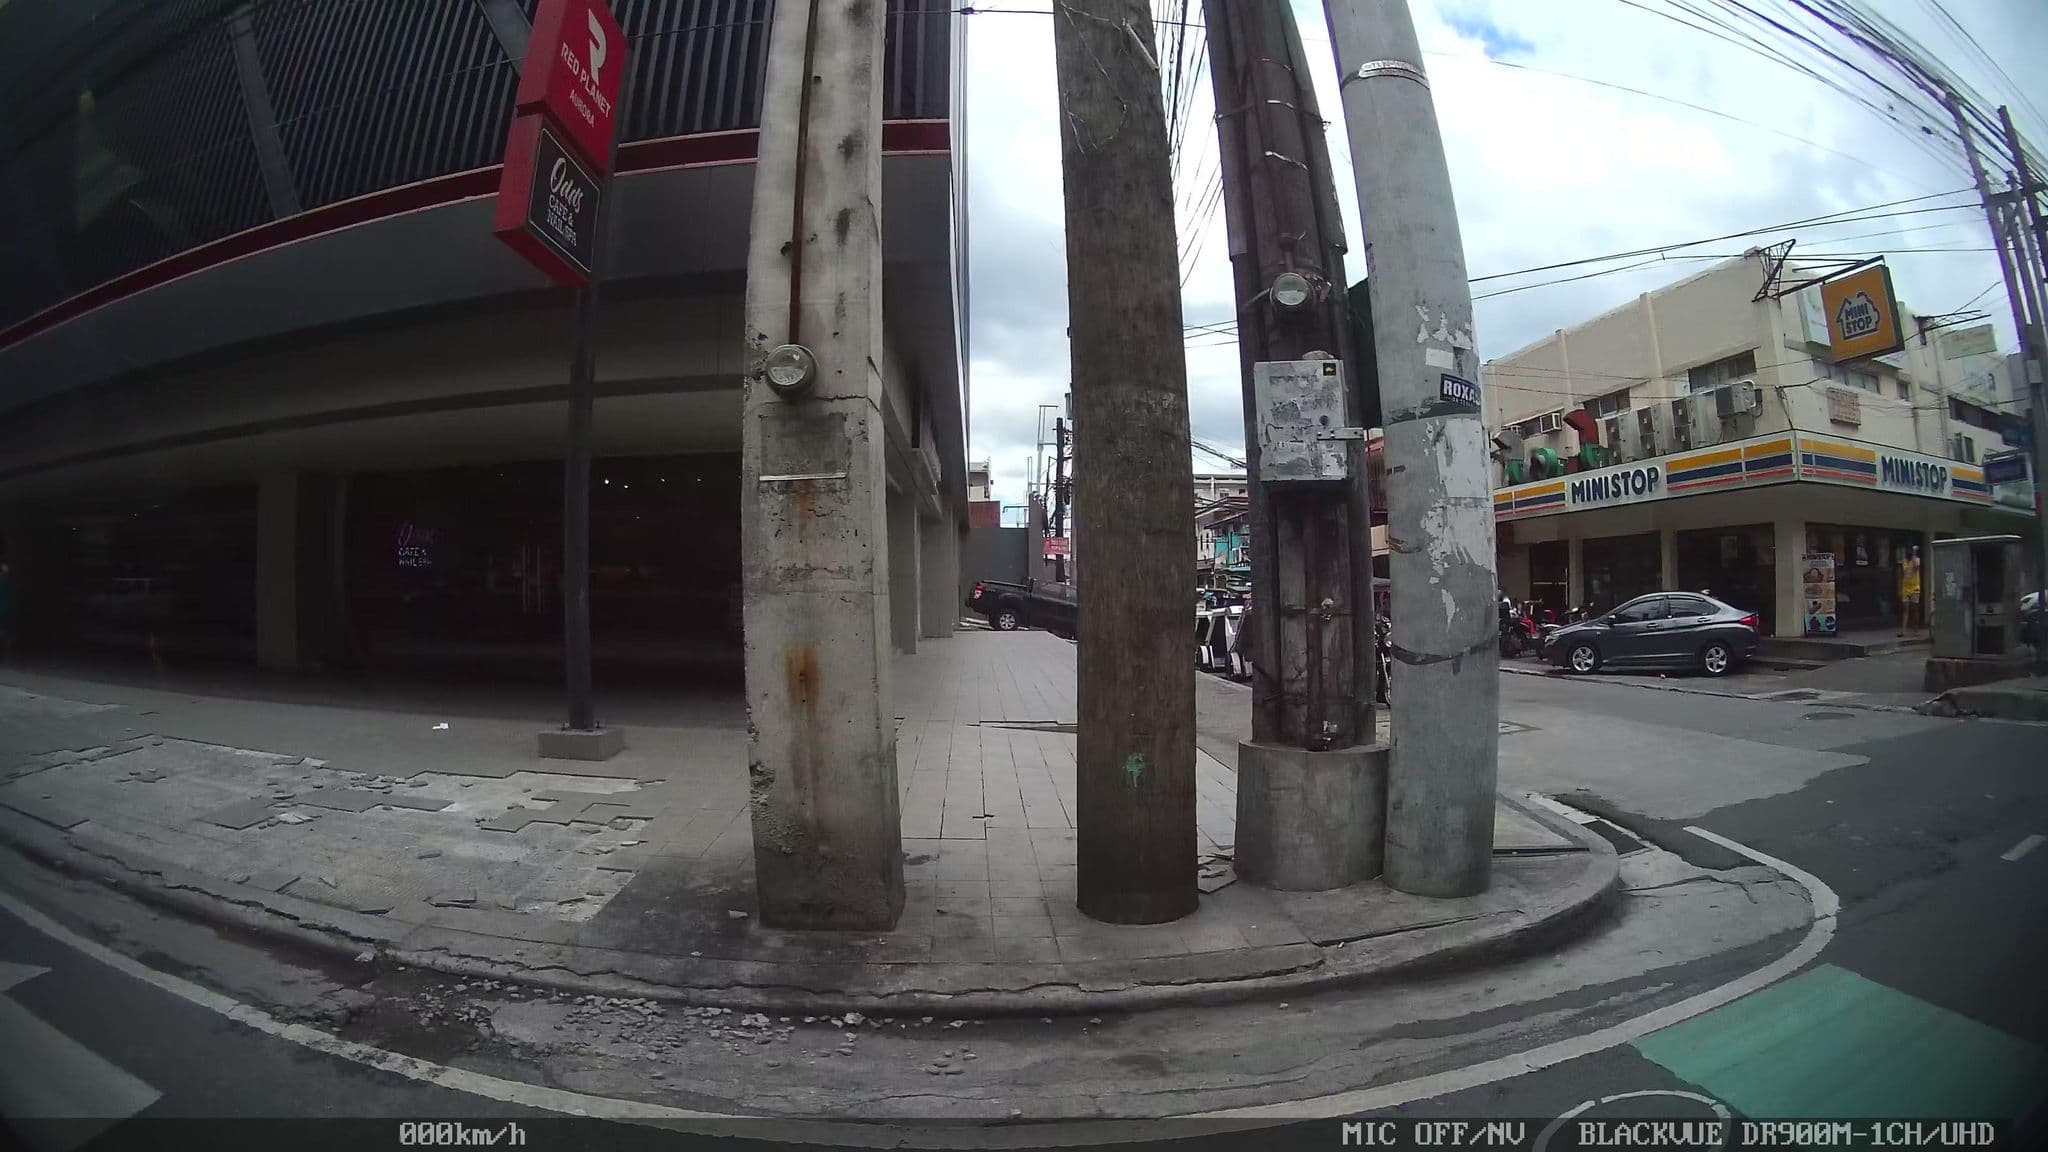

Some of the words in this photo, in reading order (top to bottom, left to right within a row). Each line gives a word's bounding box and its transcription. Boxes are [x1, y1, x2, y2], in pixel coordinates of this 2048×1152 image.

[561, 42, 579, 76] RED
[580, 68, 611, 118] PLANET
[569, 88, 595, 128] AURORA
[1845, 303, 1868, 321] MINI
[1846, 316, 1872, 334] STOP
[1571, 467, 1659, 504] MINISTOP
[1881, 456, 1947, 493] MINISTOP
